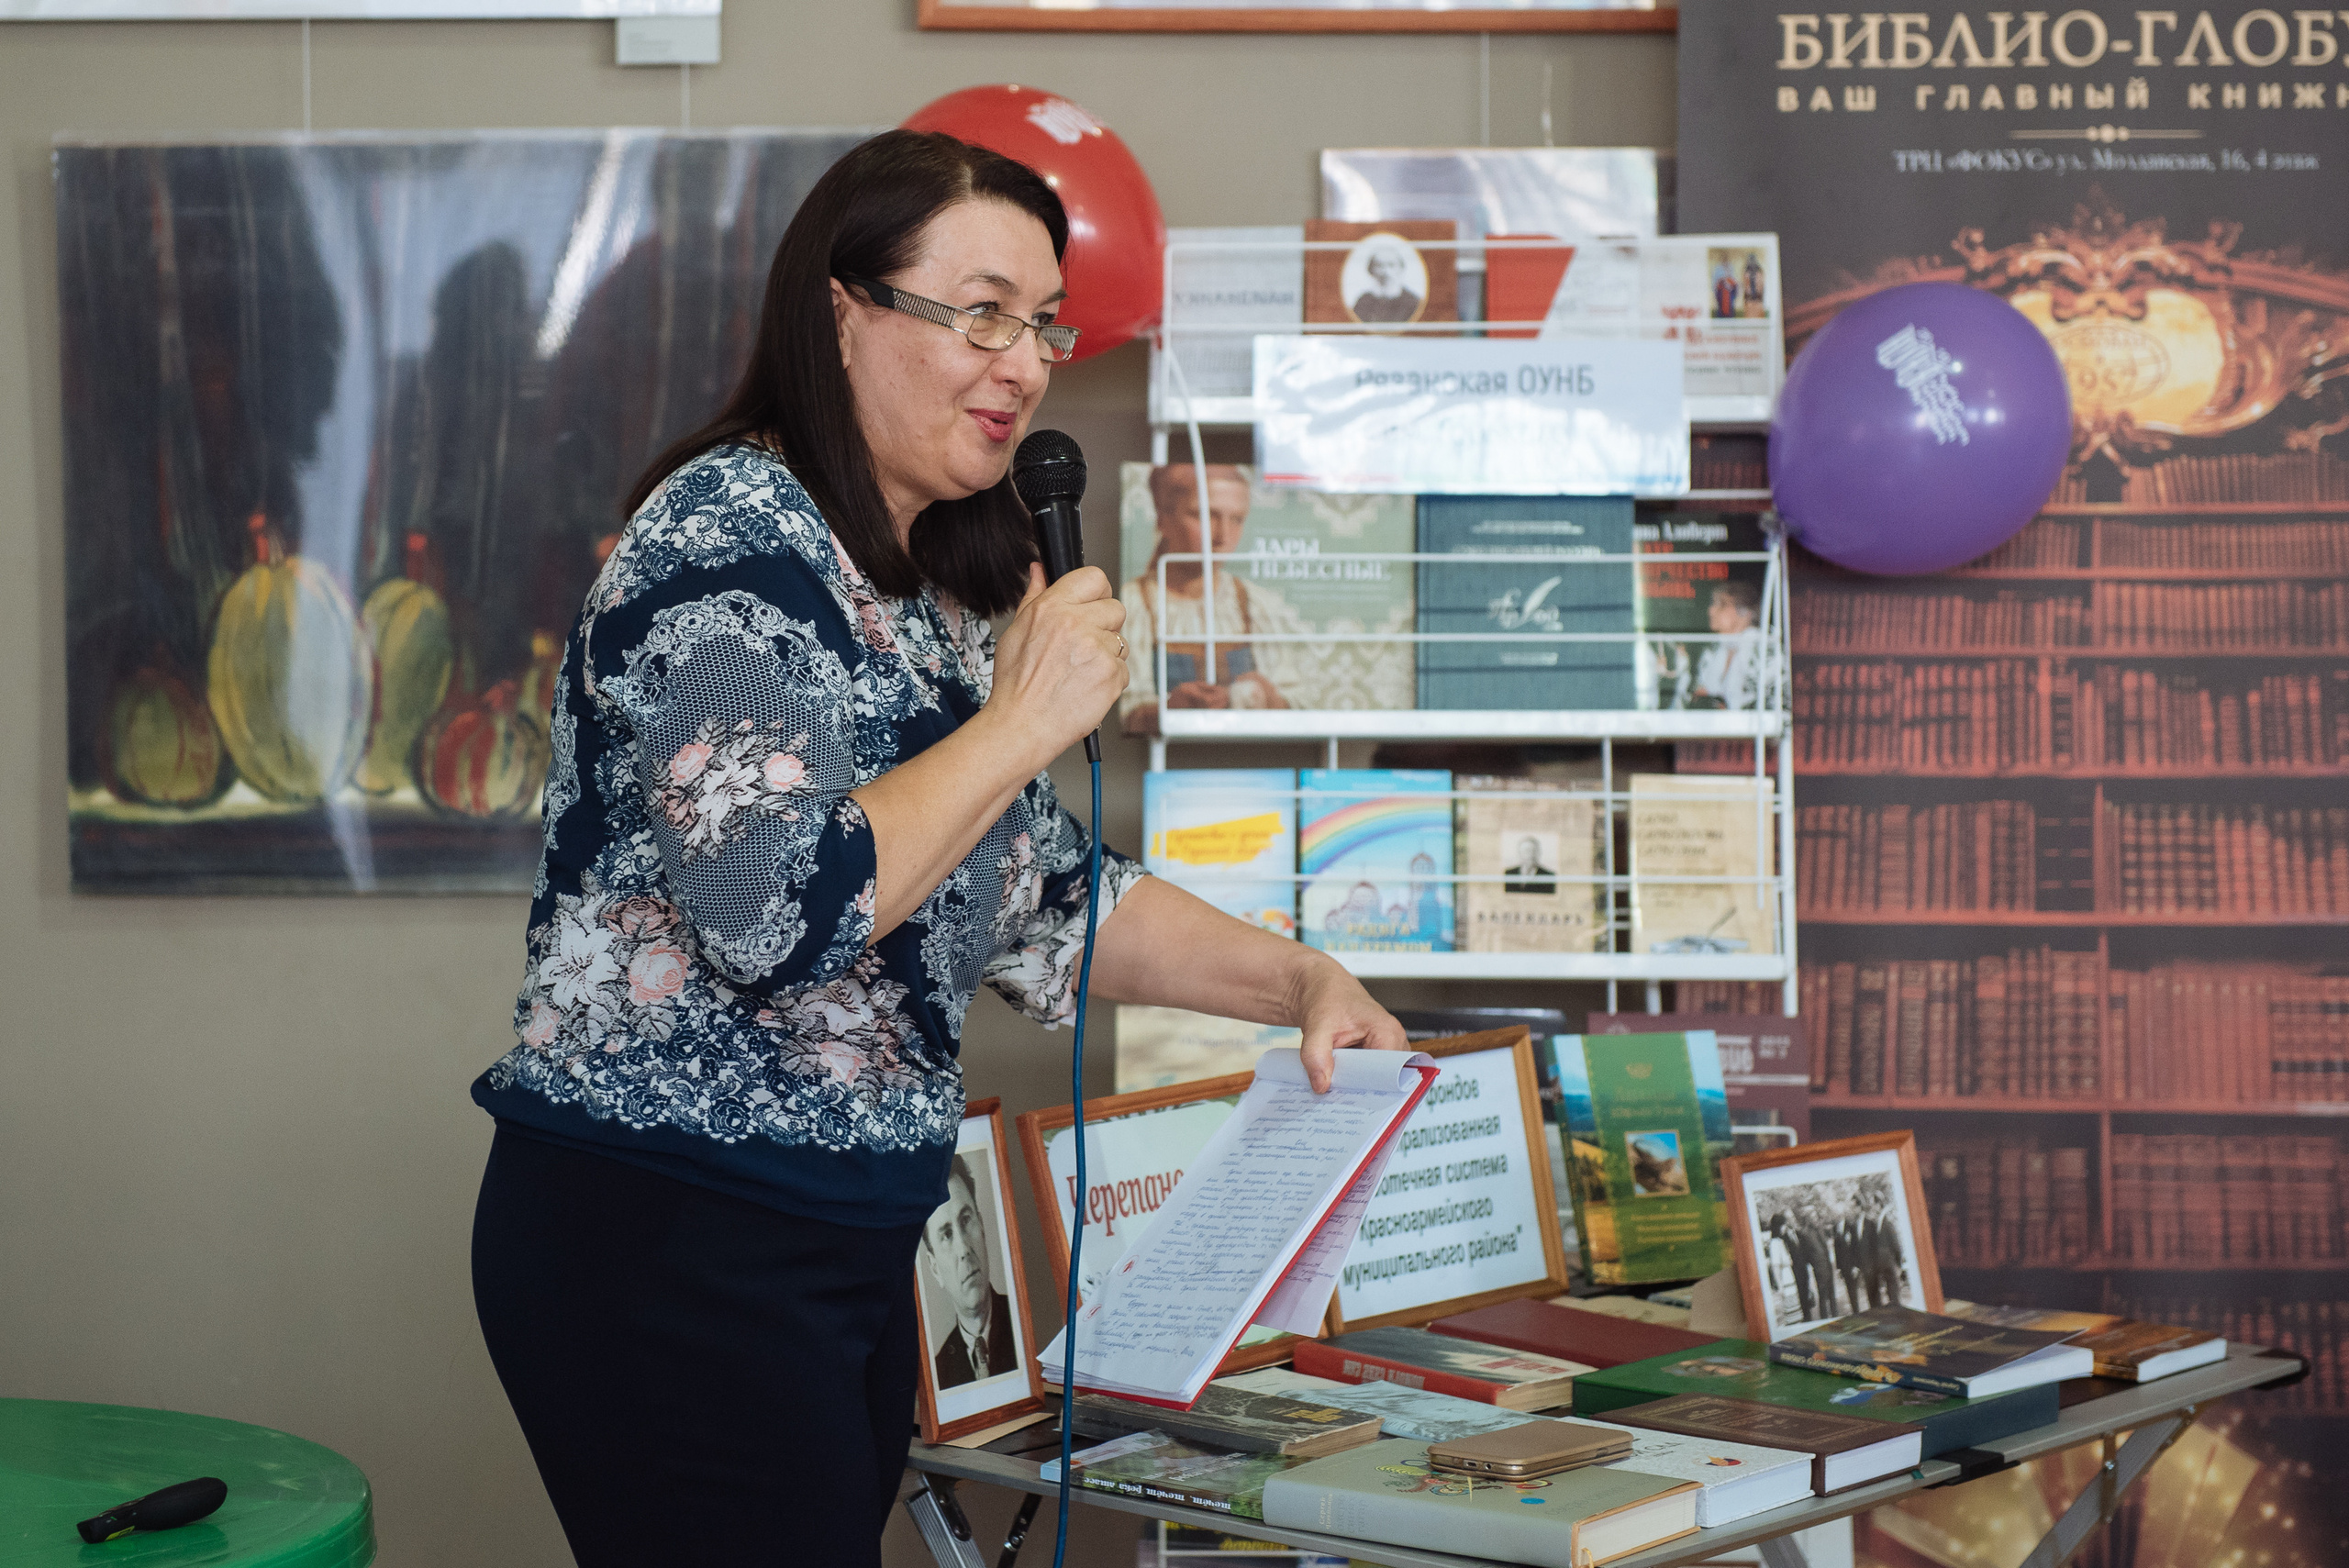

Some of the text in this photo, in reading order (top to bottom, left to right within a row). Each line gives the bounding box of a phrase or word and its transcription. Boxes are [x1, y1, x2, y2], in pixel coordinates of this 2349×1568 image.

[1776, 8, 2349, 69] БИБЛИО-ГЛОБ
[1776, 84, 1876, 112] ВАШ
[1916, 76, 2150, 110] ГЛАВНЫЙ
[1518, 364, 1596, 396] ОУНБ
[1445, 1153, 1509, 1184] система
[1342, 1242, 1466, 1292] муниципального
[1119, 1482, 1142, 1495] река
[1146, 1487, 1186, 1502] течёт
